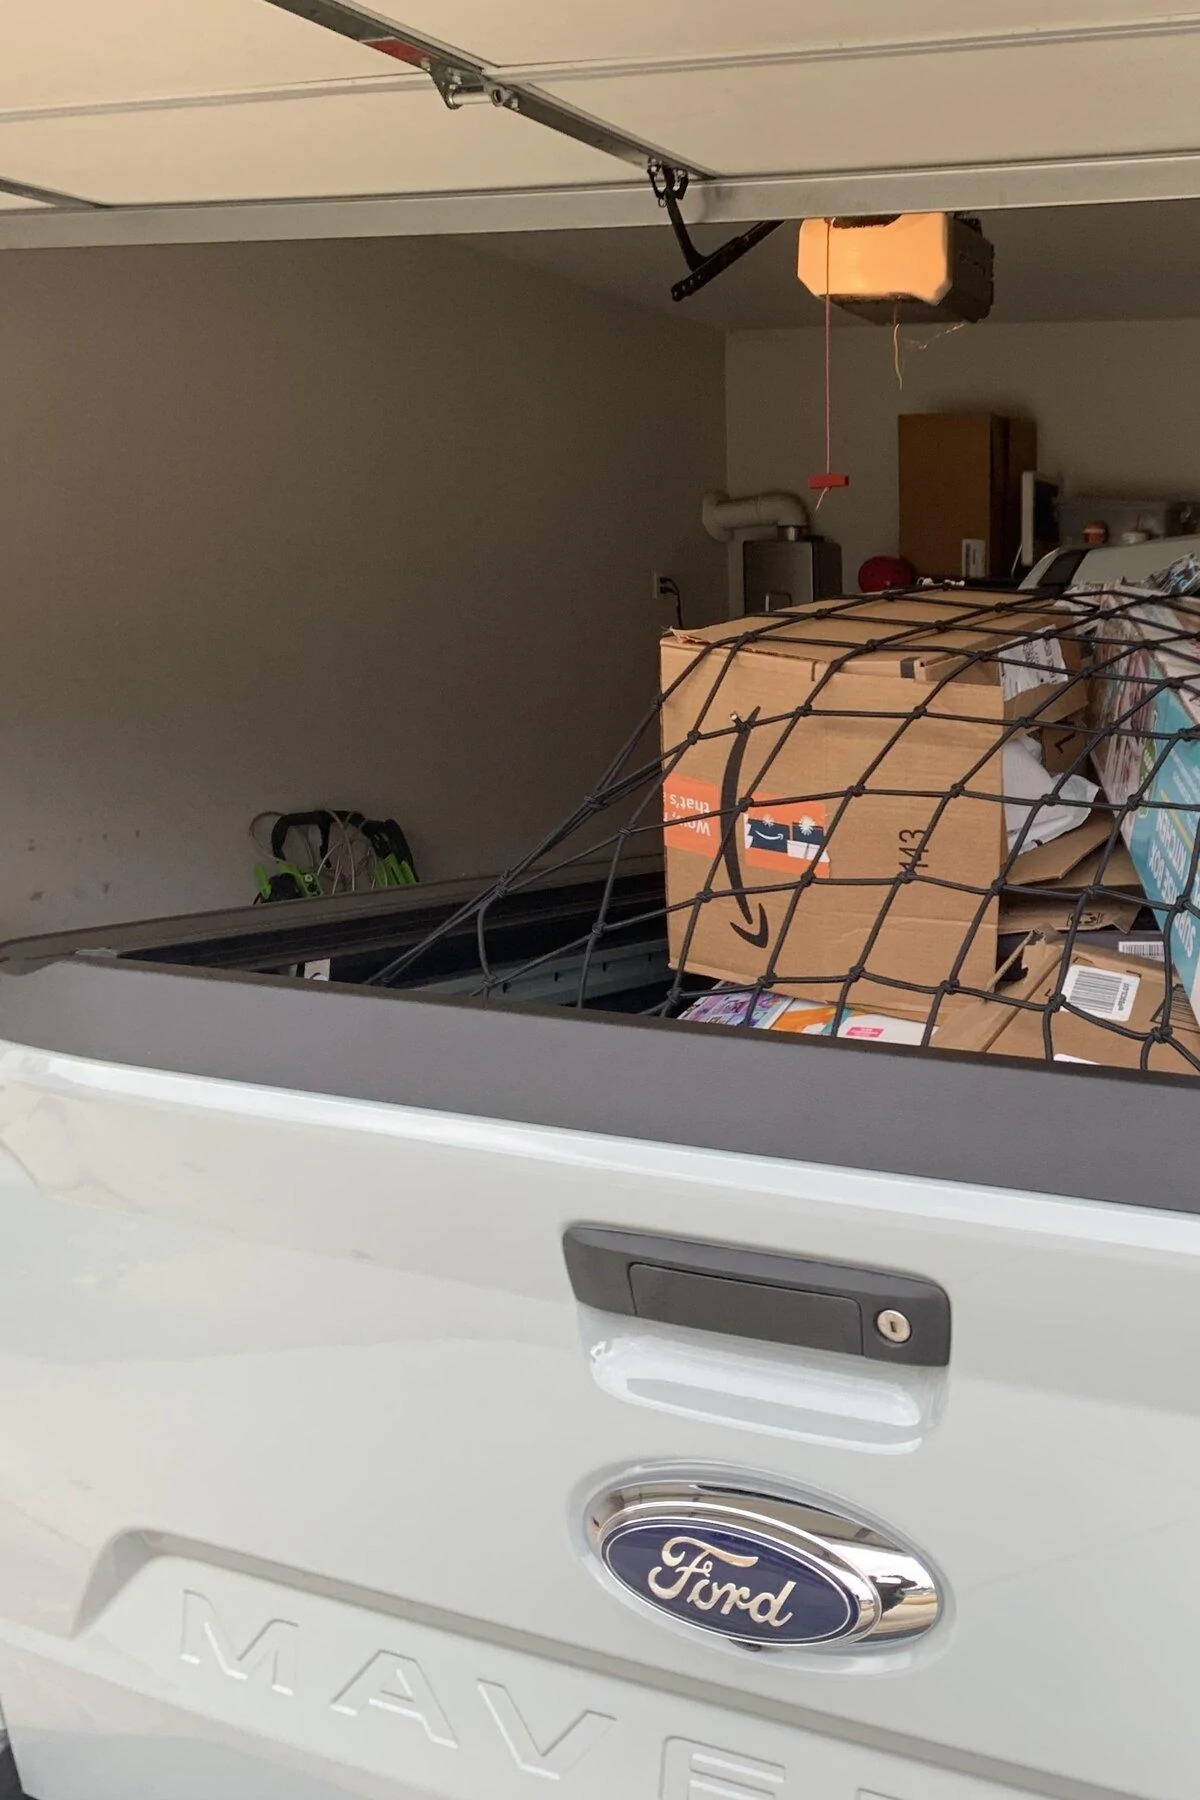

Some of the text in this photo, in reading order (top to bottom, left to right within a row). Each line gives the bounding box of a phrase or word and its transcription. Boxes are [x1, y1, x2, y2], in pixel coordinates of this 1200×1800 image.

[669, 793, 710, 814] that's
[646, 1535, 798, 1628] Ford
[180, 1588, 906, 1800] MAVE
